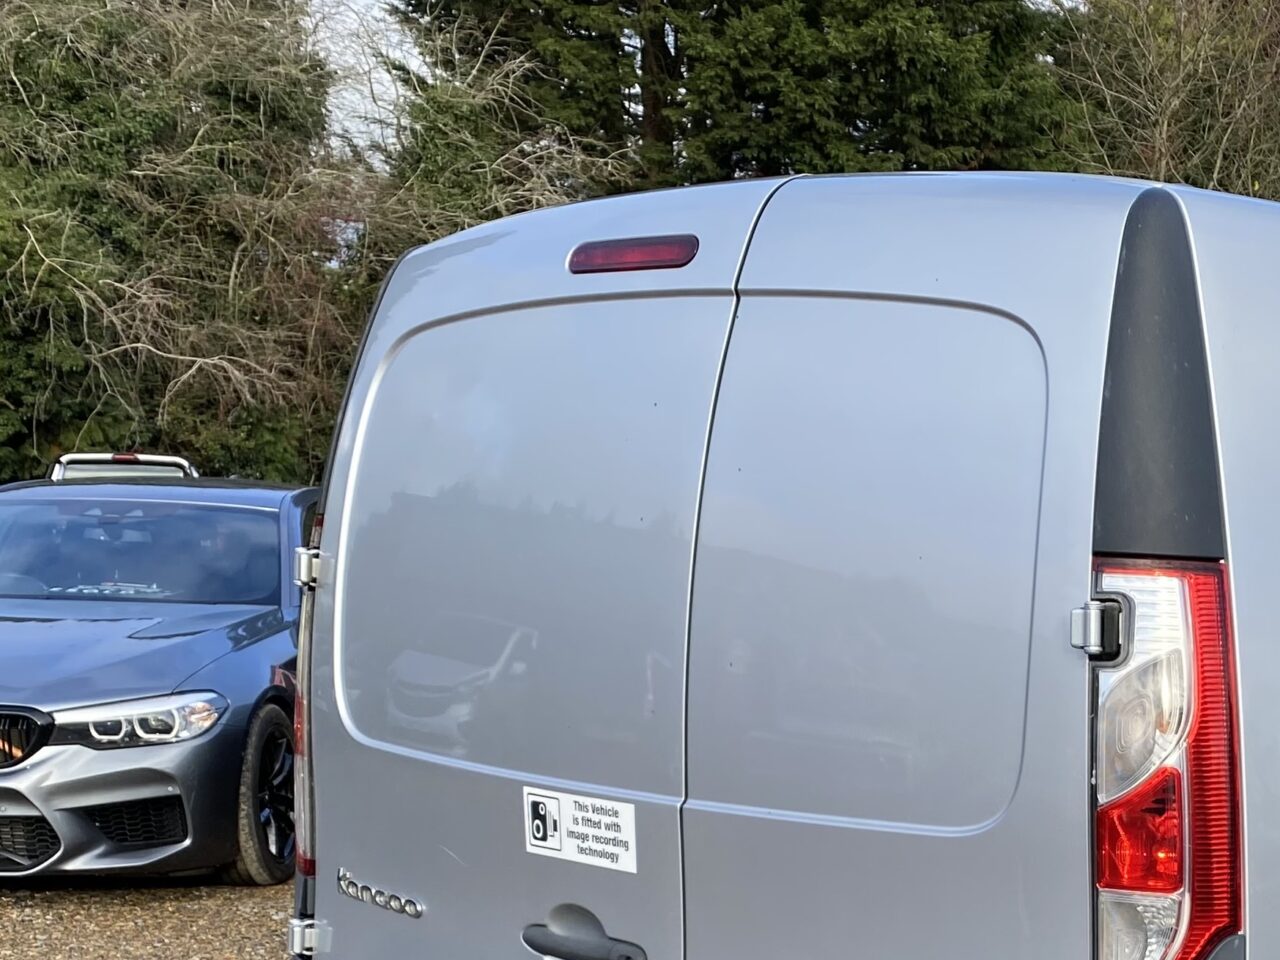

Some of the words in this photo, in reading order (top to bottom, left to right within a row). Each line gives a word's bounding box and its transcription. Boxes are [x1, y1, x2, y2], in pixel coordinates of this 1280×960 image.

[573, 800, 589, 813] This
[590, 803, 619, 818] Vehicle
[572, 814, 580, 826] is
[581, 816, 602, 830] fitted
[604, 821, 622, 833] with
[566, 827, 590, 843] image
[591, 834, 629, 852] recording
[576, 844, 619, 863] technology
